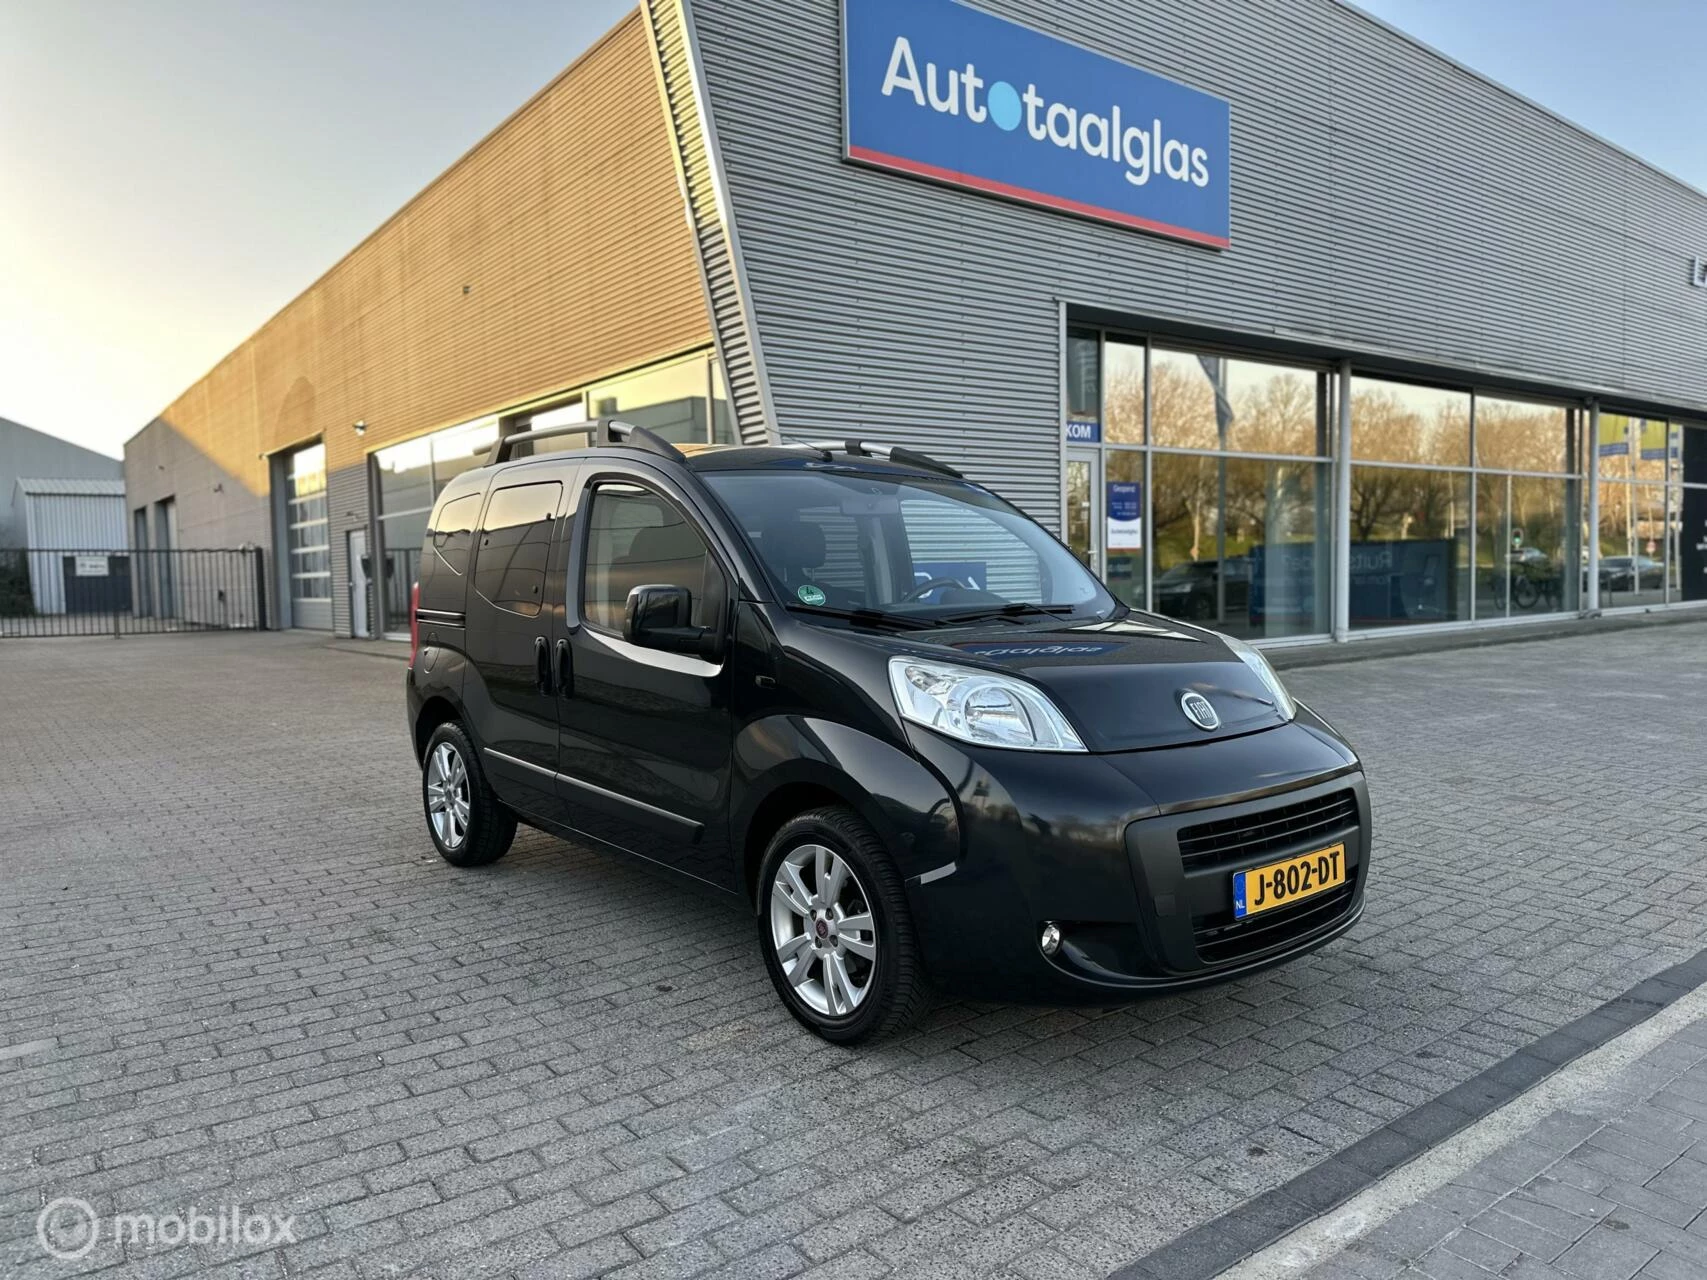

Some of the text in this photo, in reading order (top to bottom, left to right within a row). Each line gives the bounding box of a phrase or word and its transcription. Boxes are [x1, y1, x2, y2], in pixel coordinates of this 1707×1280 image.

[881, 36, 1209, 187] Autotaalglas
[1235, 900, 1245, 910] NL
[1254, 851, 1340, 906] J-802-DT
